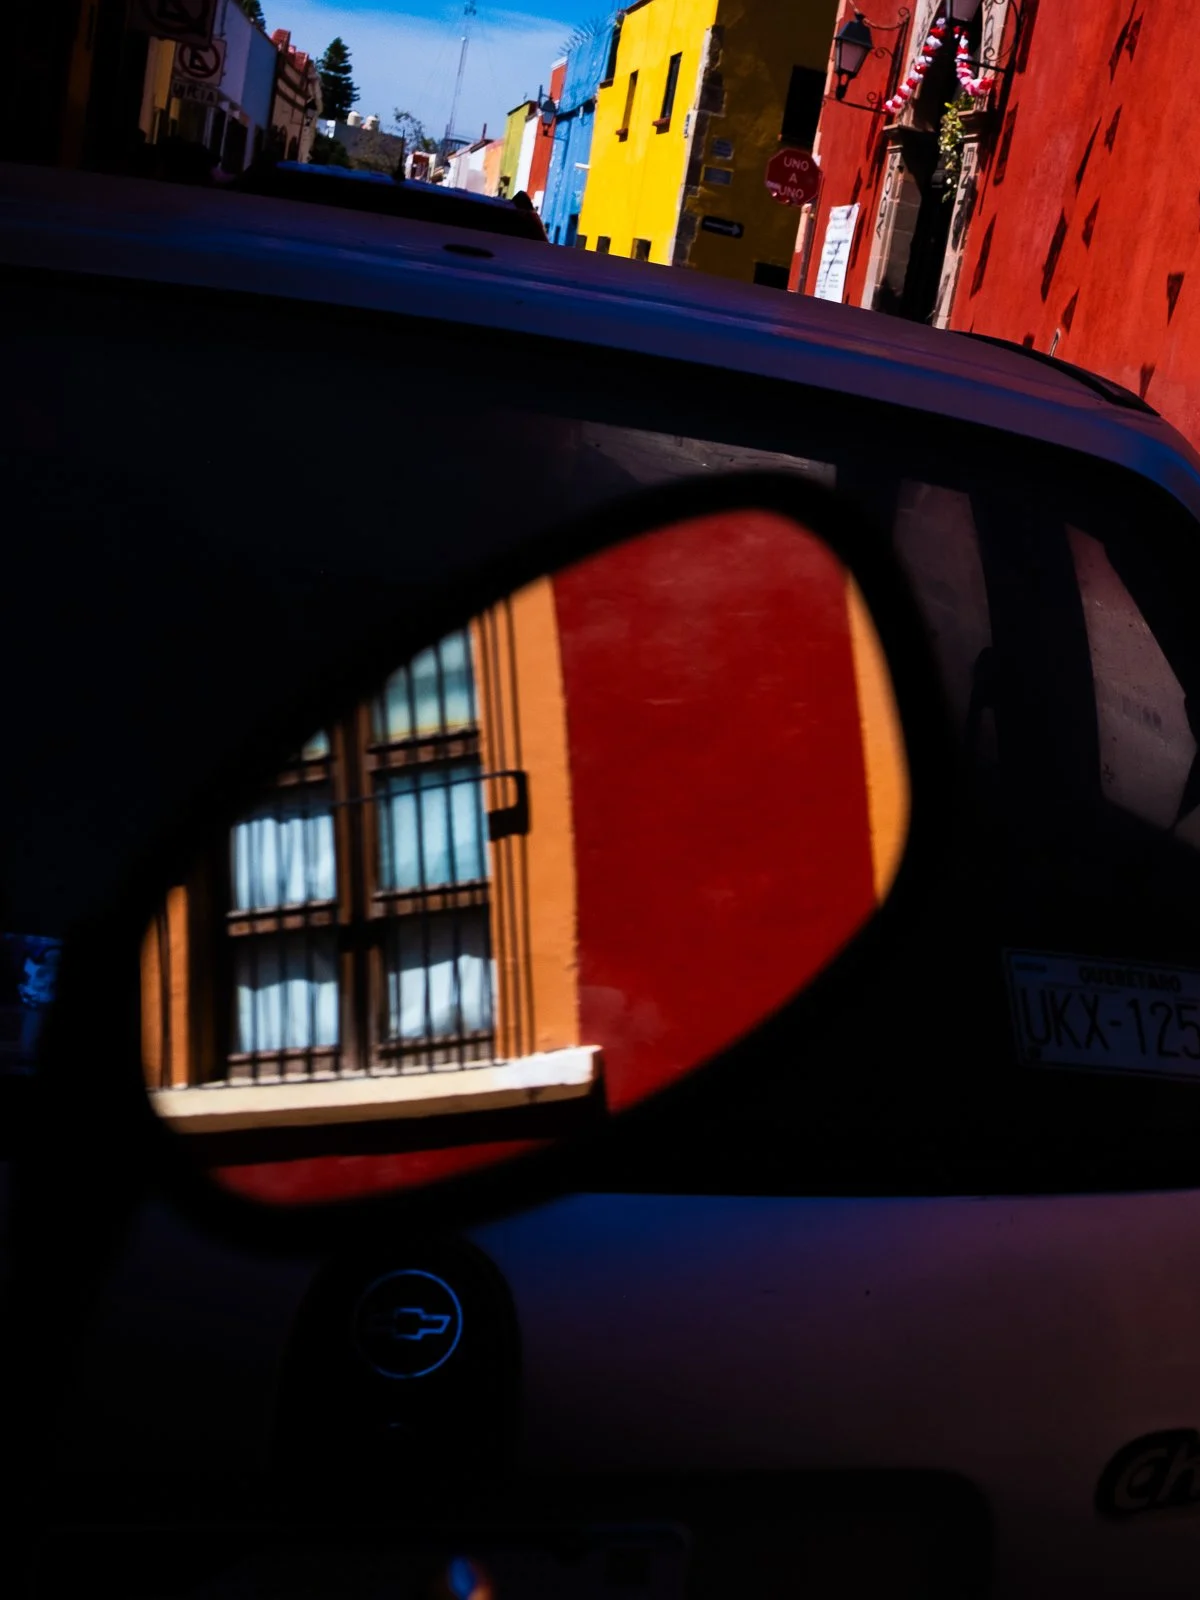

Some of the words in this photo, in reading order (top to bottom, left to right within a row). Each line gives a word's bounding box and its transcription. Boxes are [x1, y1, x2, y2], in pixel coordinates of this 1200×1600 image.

[783, 155, 810, 172] UNO
[787, 172, 799, 184] A
[779, 185, 805, 200] UNO
